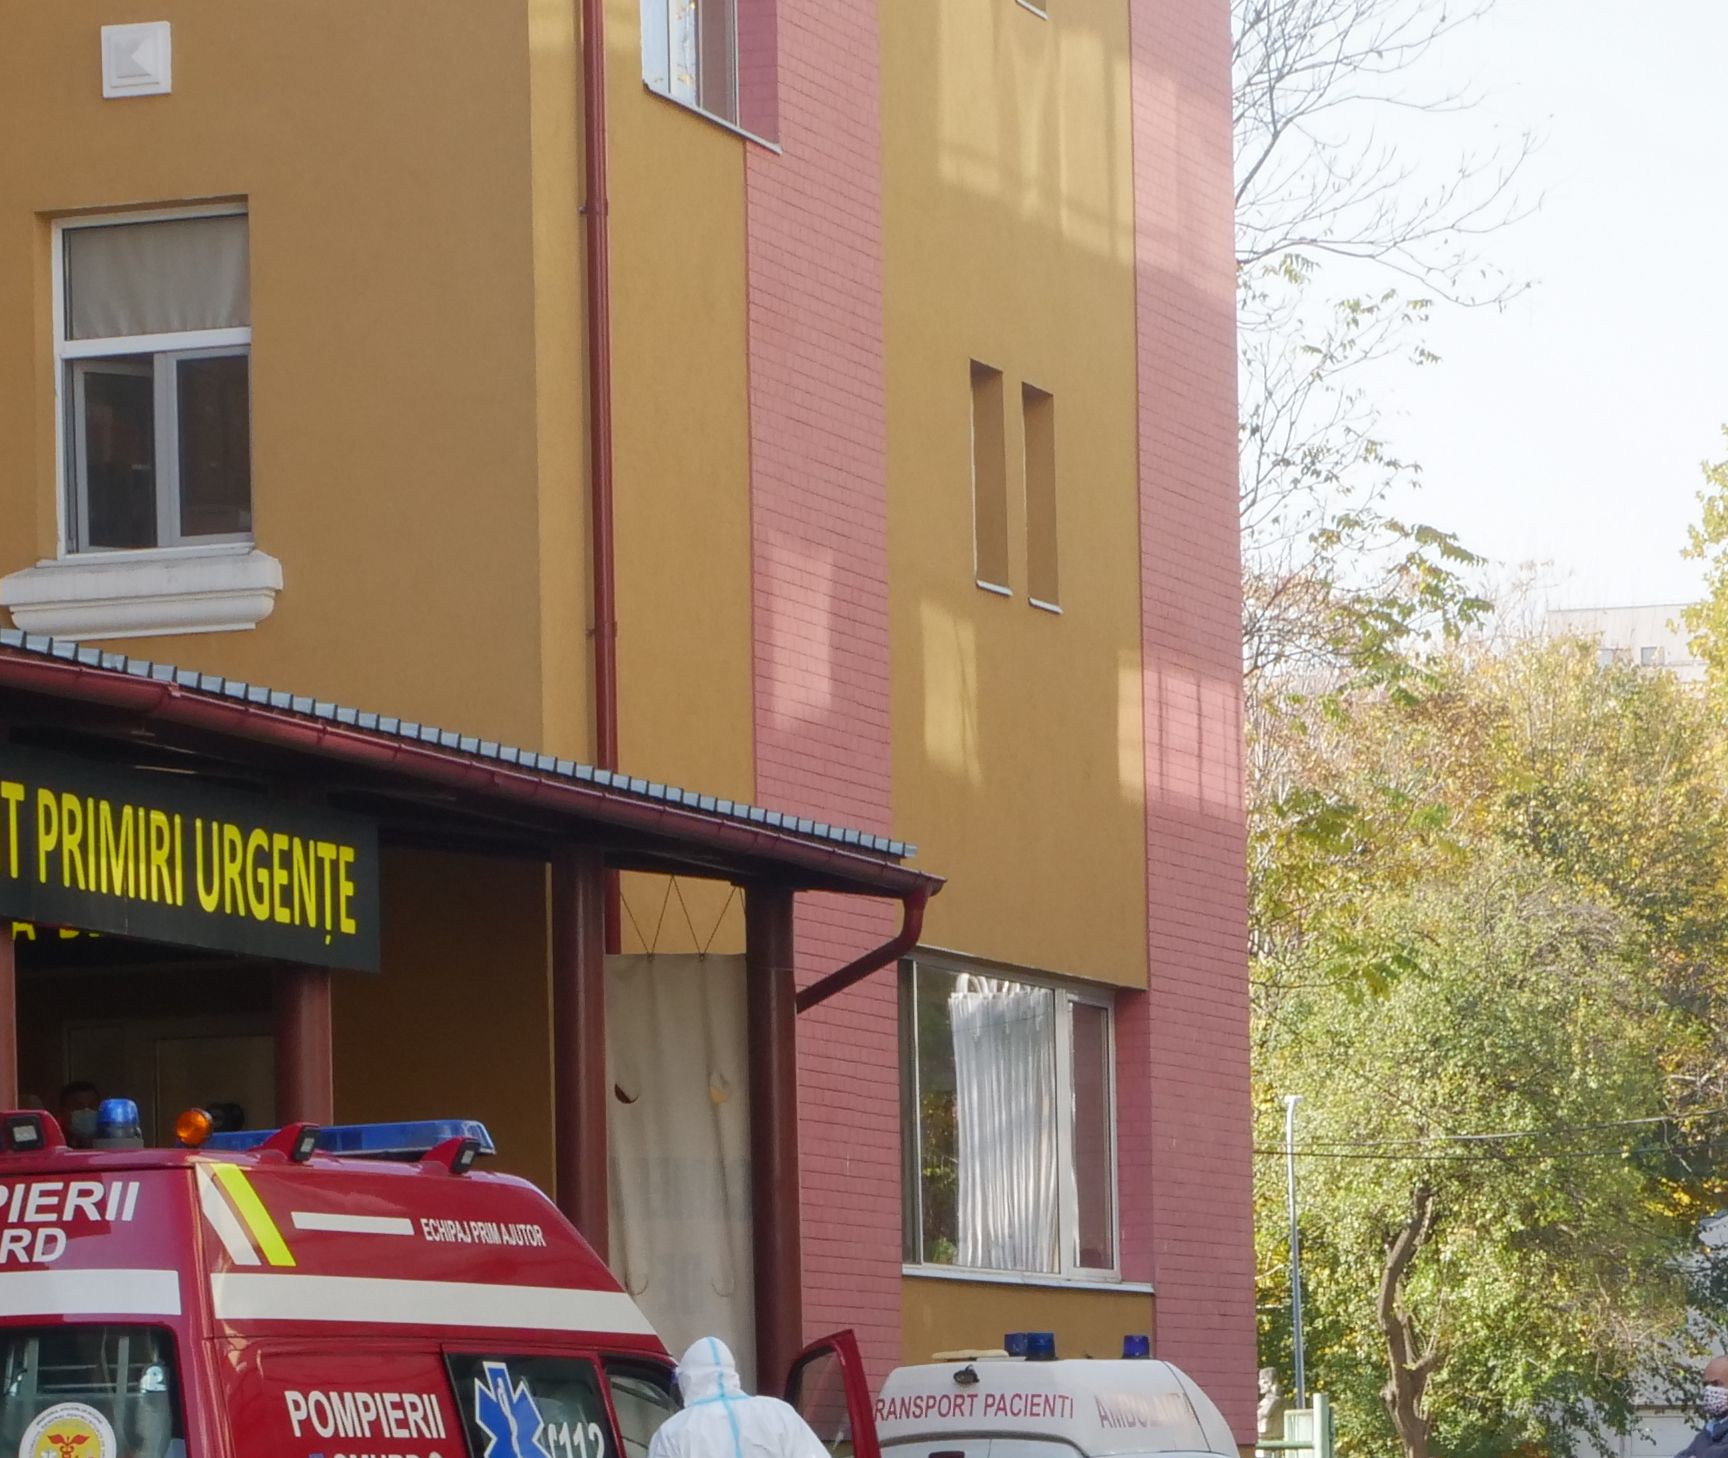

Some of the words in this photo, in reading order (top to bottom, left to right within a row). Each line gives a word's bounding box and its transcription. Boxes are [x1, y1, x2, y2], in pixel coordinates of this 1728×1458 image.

[37, 788, 183, 907] PRIMIRI
[193, 817, 357, 945] URGENȚE
[421, 1218, 471, 1244] ECHIPAJ
[472, 1221, 501, 1246] PRIM
[500, 1223, 547, 1248] AJUTOR
[285, 1390, 446, 1439] POMPIERII
[874, 1393, 978, 1423] RANSPORT
[983, 1394, 1073, 1418] PACIENTI
